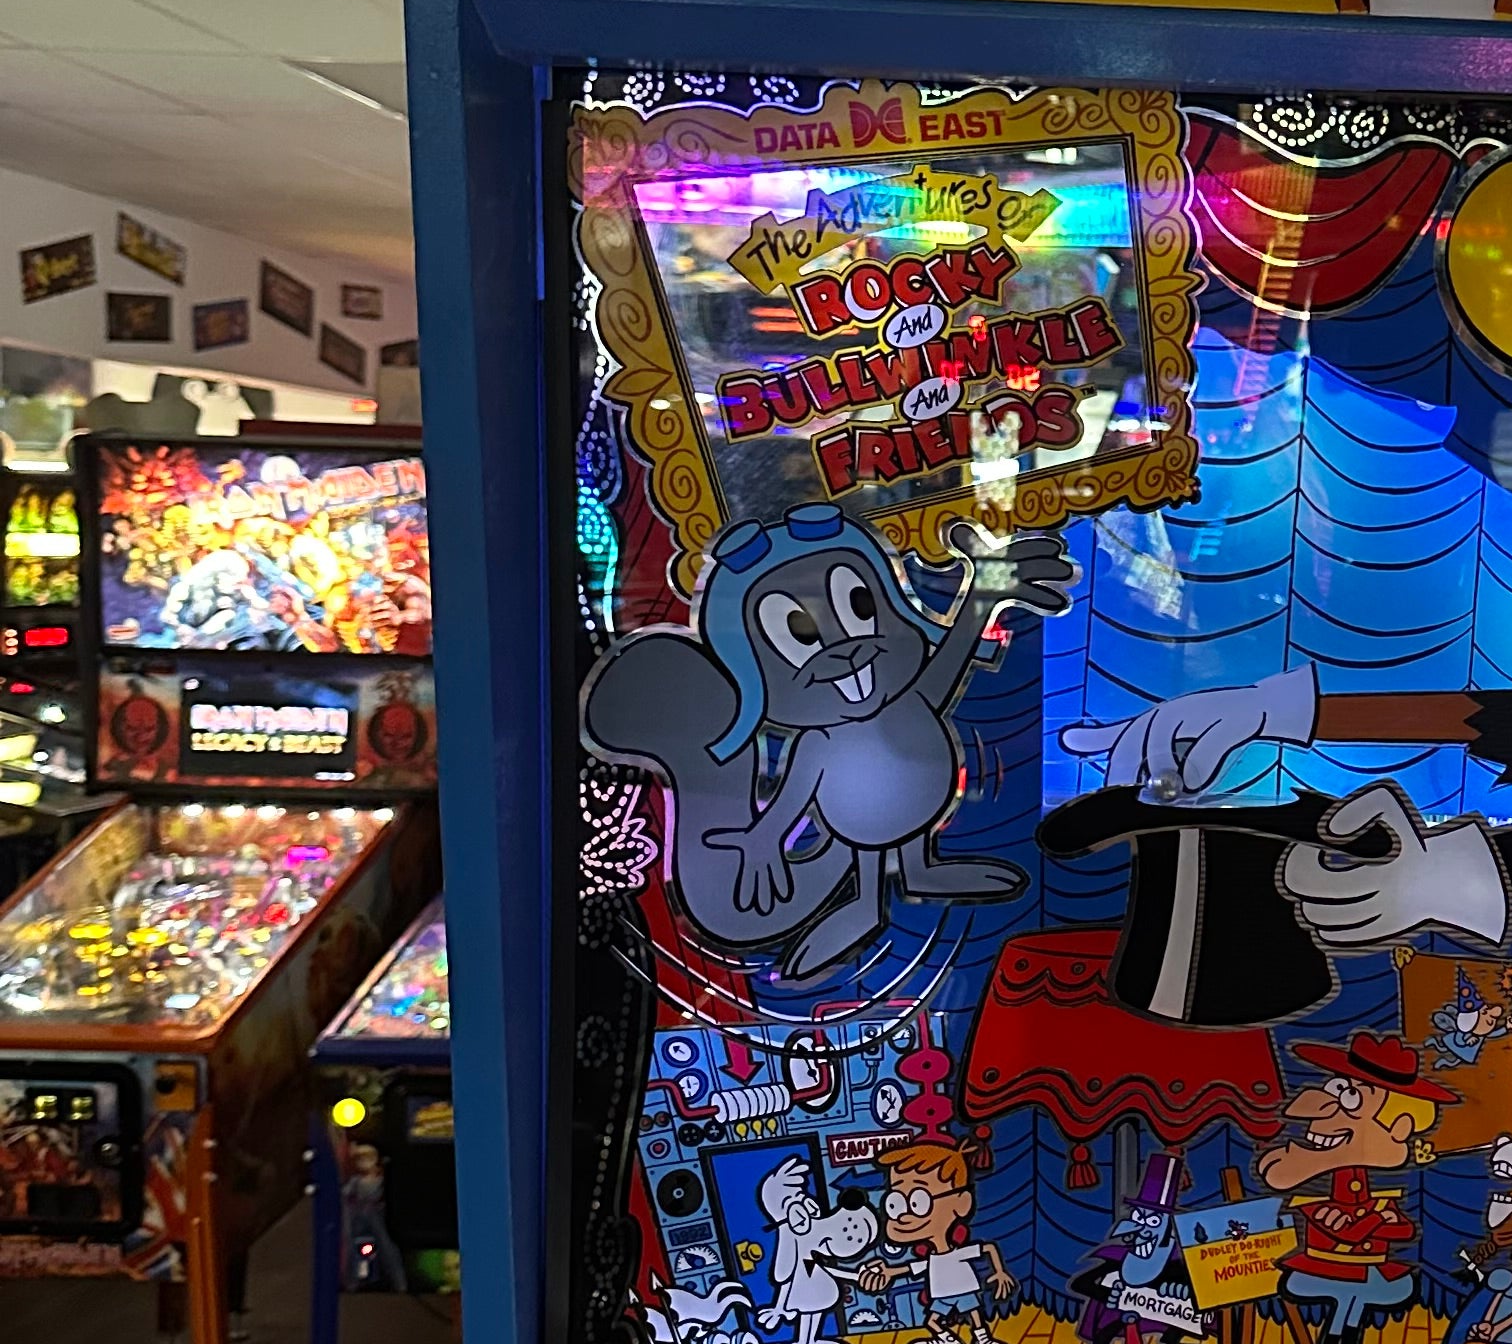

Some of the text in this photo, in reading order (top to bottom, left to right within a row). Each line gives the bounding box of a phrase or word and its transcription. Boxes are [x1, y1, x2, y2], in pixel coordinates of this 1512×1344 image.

[753, 120, 841, 154] DATA
[918, 109, 1007, 142] EAST
[746, 227, 812, 282] The
[794, 245, 1014, 334] ROCKY
[892, 304, 934, 343] And
[723, 299, 1119, 437] BULLWINKLE
[909, 380, 950, 416] And
[1200, 1242, 1238, 1261] DUDLEY
[1214, 1257, 1277, 1283] MOUNTIES
[1242, 1250, 1261, 1261] THE
[1124, 1291, 1201, 1325] MORTGAGE
